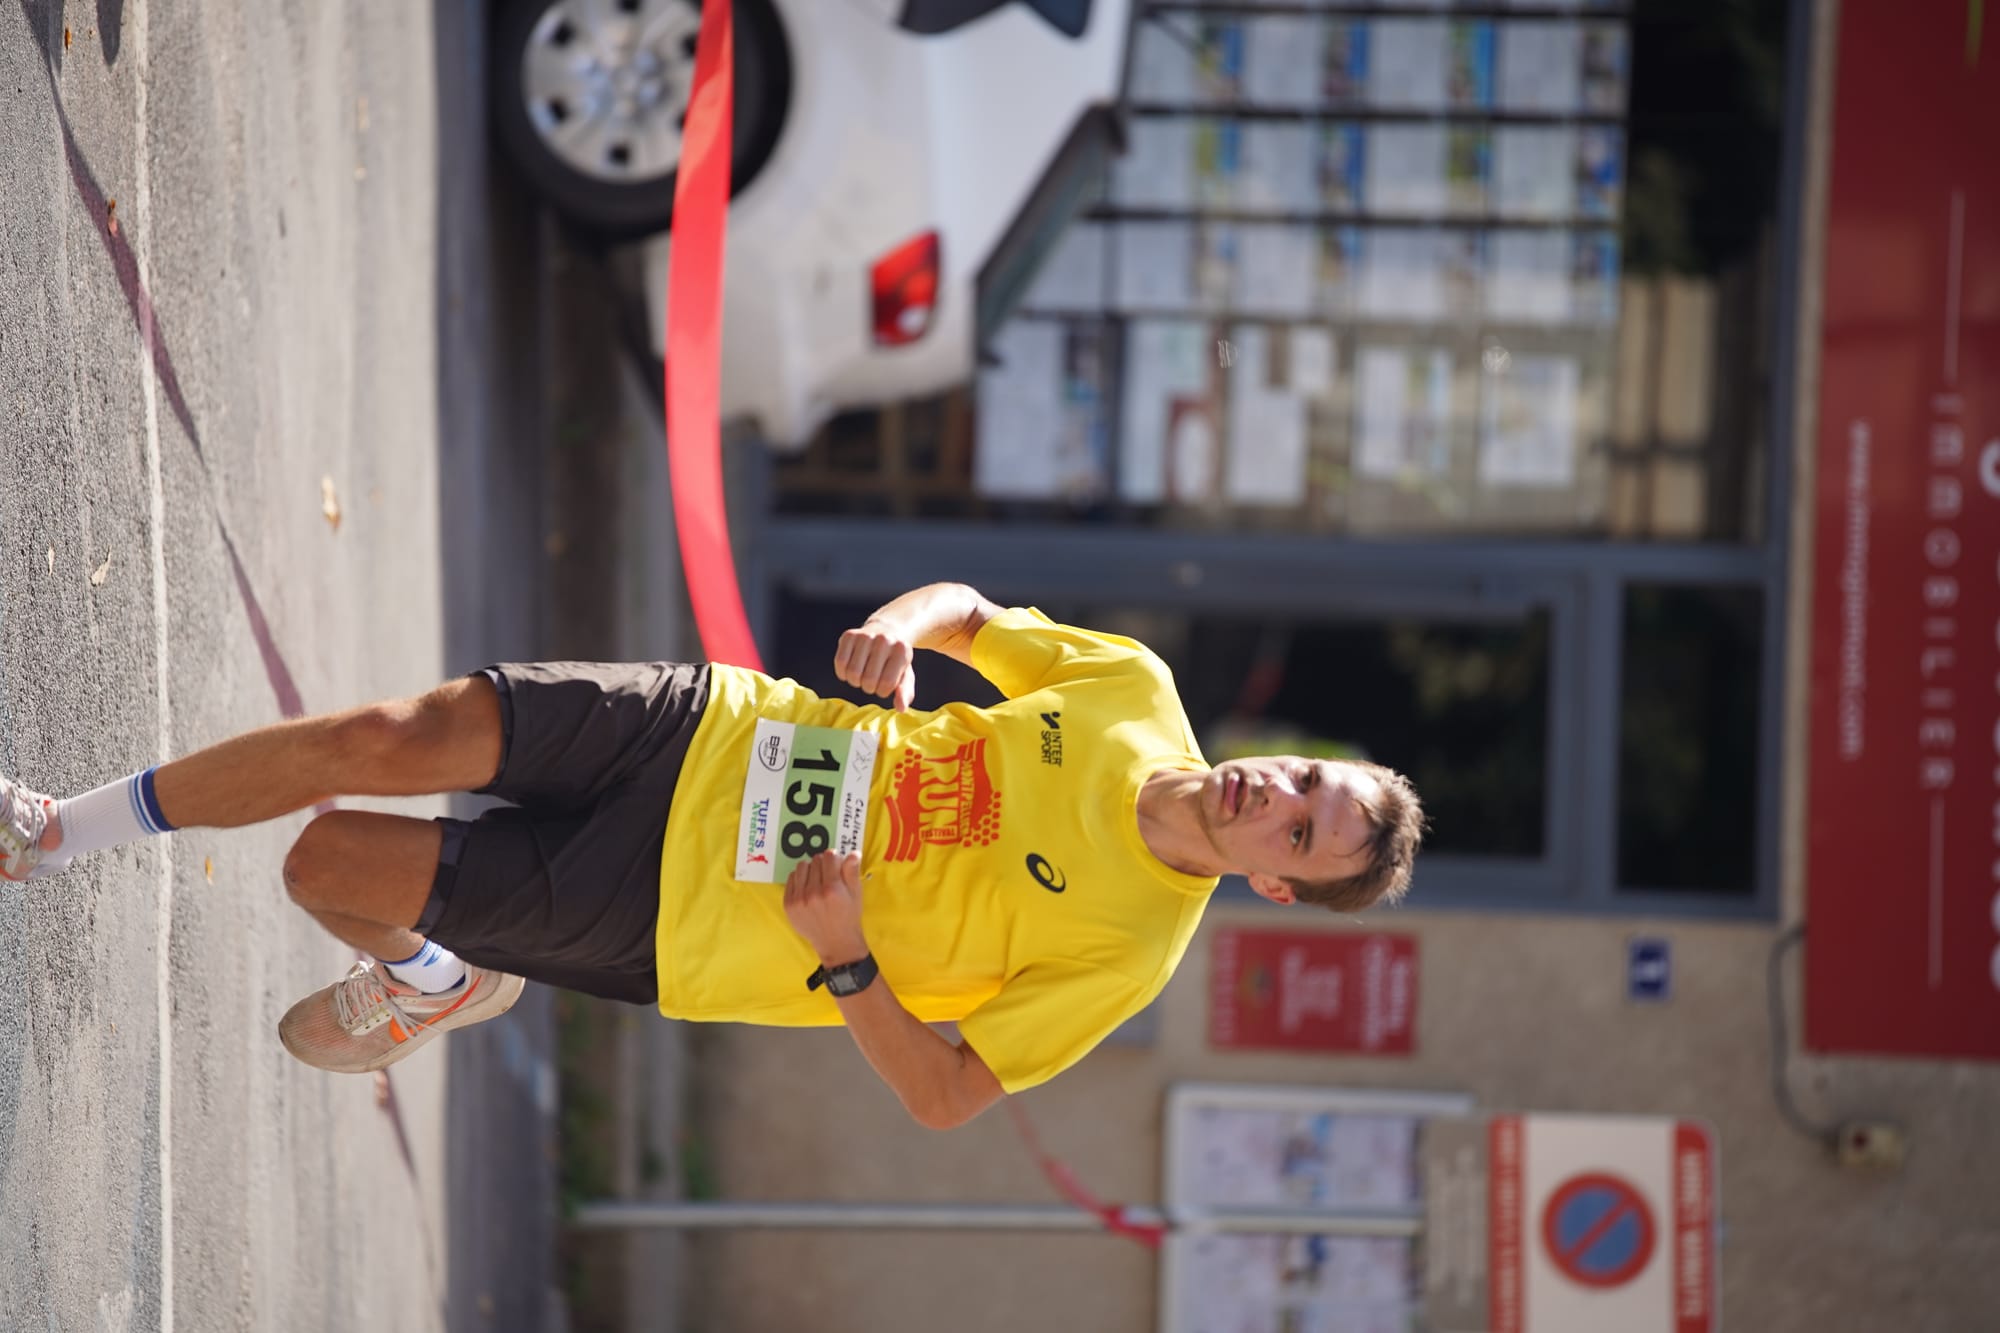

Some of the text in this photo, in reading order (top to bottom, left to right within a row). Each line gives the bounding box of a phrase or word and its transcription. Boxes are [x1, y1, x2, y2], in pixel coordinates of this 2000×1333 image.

[1919, 393, 1964, 789] IMMOBILIER
[767, 735, 781, 766] BFP
[1040, 730, 1051, 764] SPORT
[1051, 731, 1062, 767] INTER
[781, 749, 841, 859] 158
[919, 758, 960, 832] RUN
[747, 802, 758, 853] Aventure
[755, 798, 770, 848] TUFF'S
